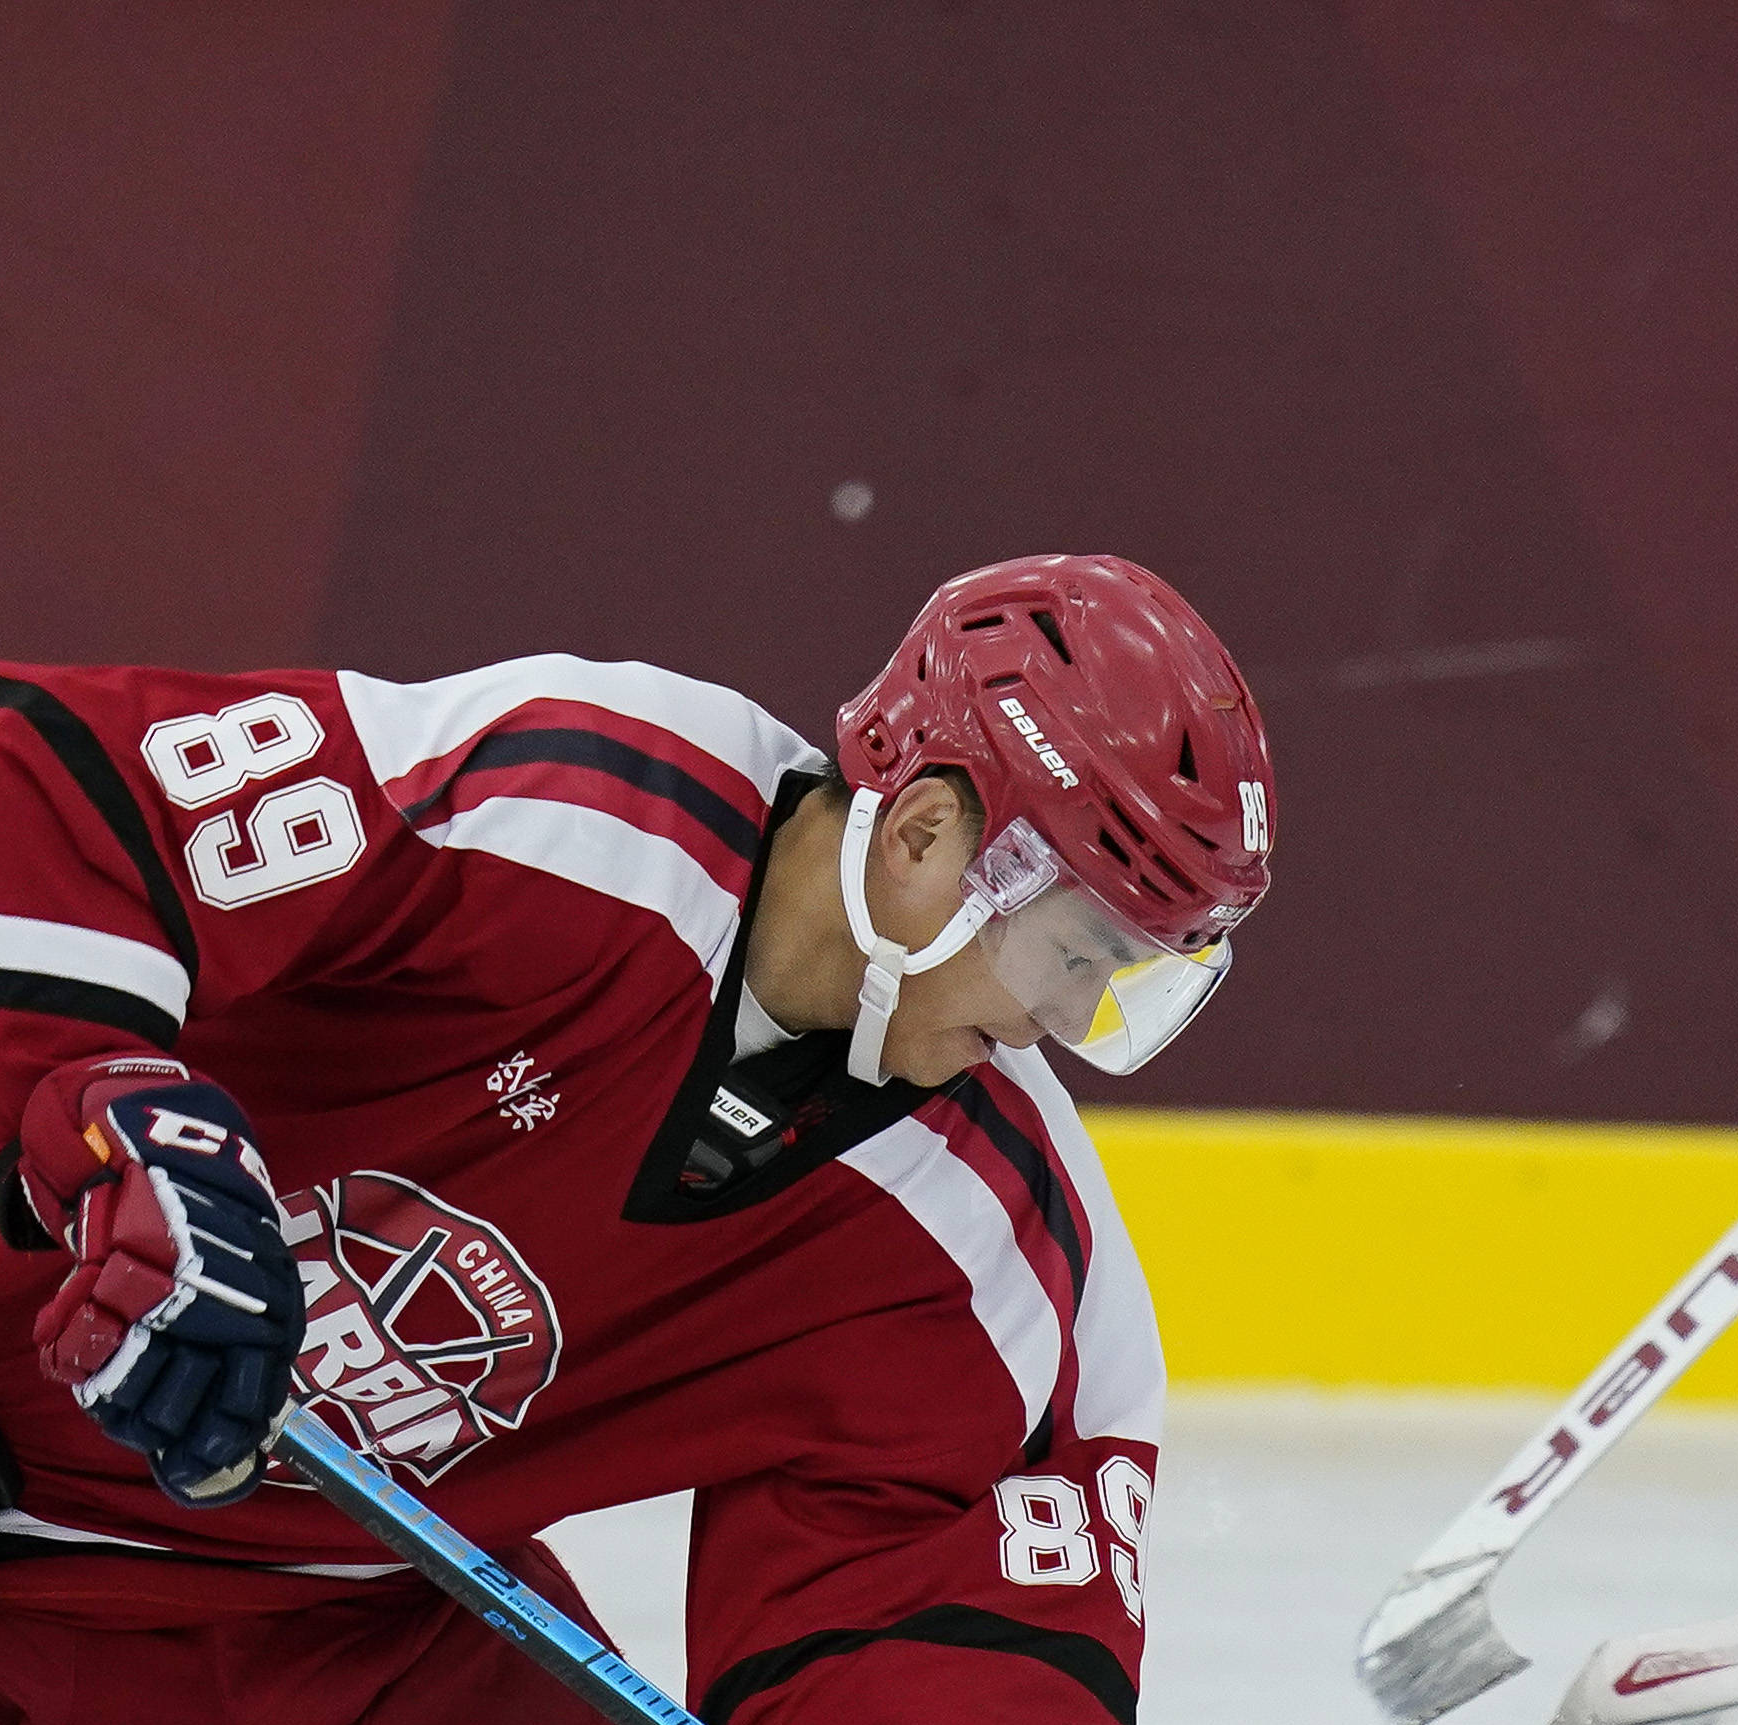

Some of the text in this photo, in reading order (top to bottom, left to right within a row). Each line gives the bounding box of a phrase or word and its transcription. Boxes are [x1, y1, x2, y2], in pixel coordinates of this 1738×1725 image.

[141, 691, 366, 912] 89
[998, 698, 1080, 791] BAUER
[456, 1240, 534, 1331] CHINA
[288, 1413, 468, 1562] EXUS
[992, 1454, 1155, 1628] 89
